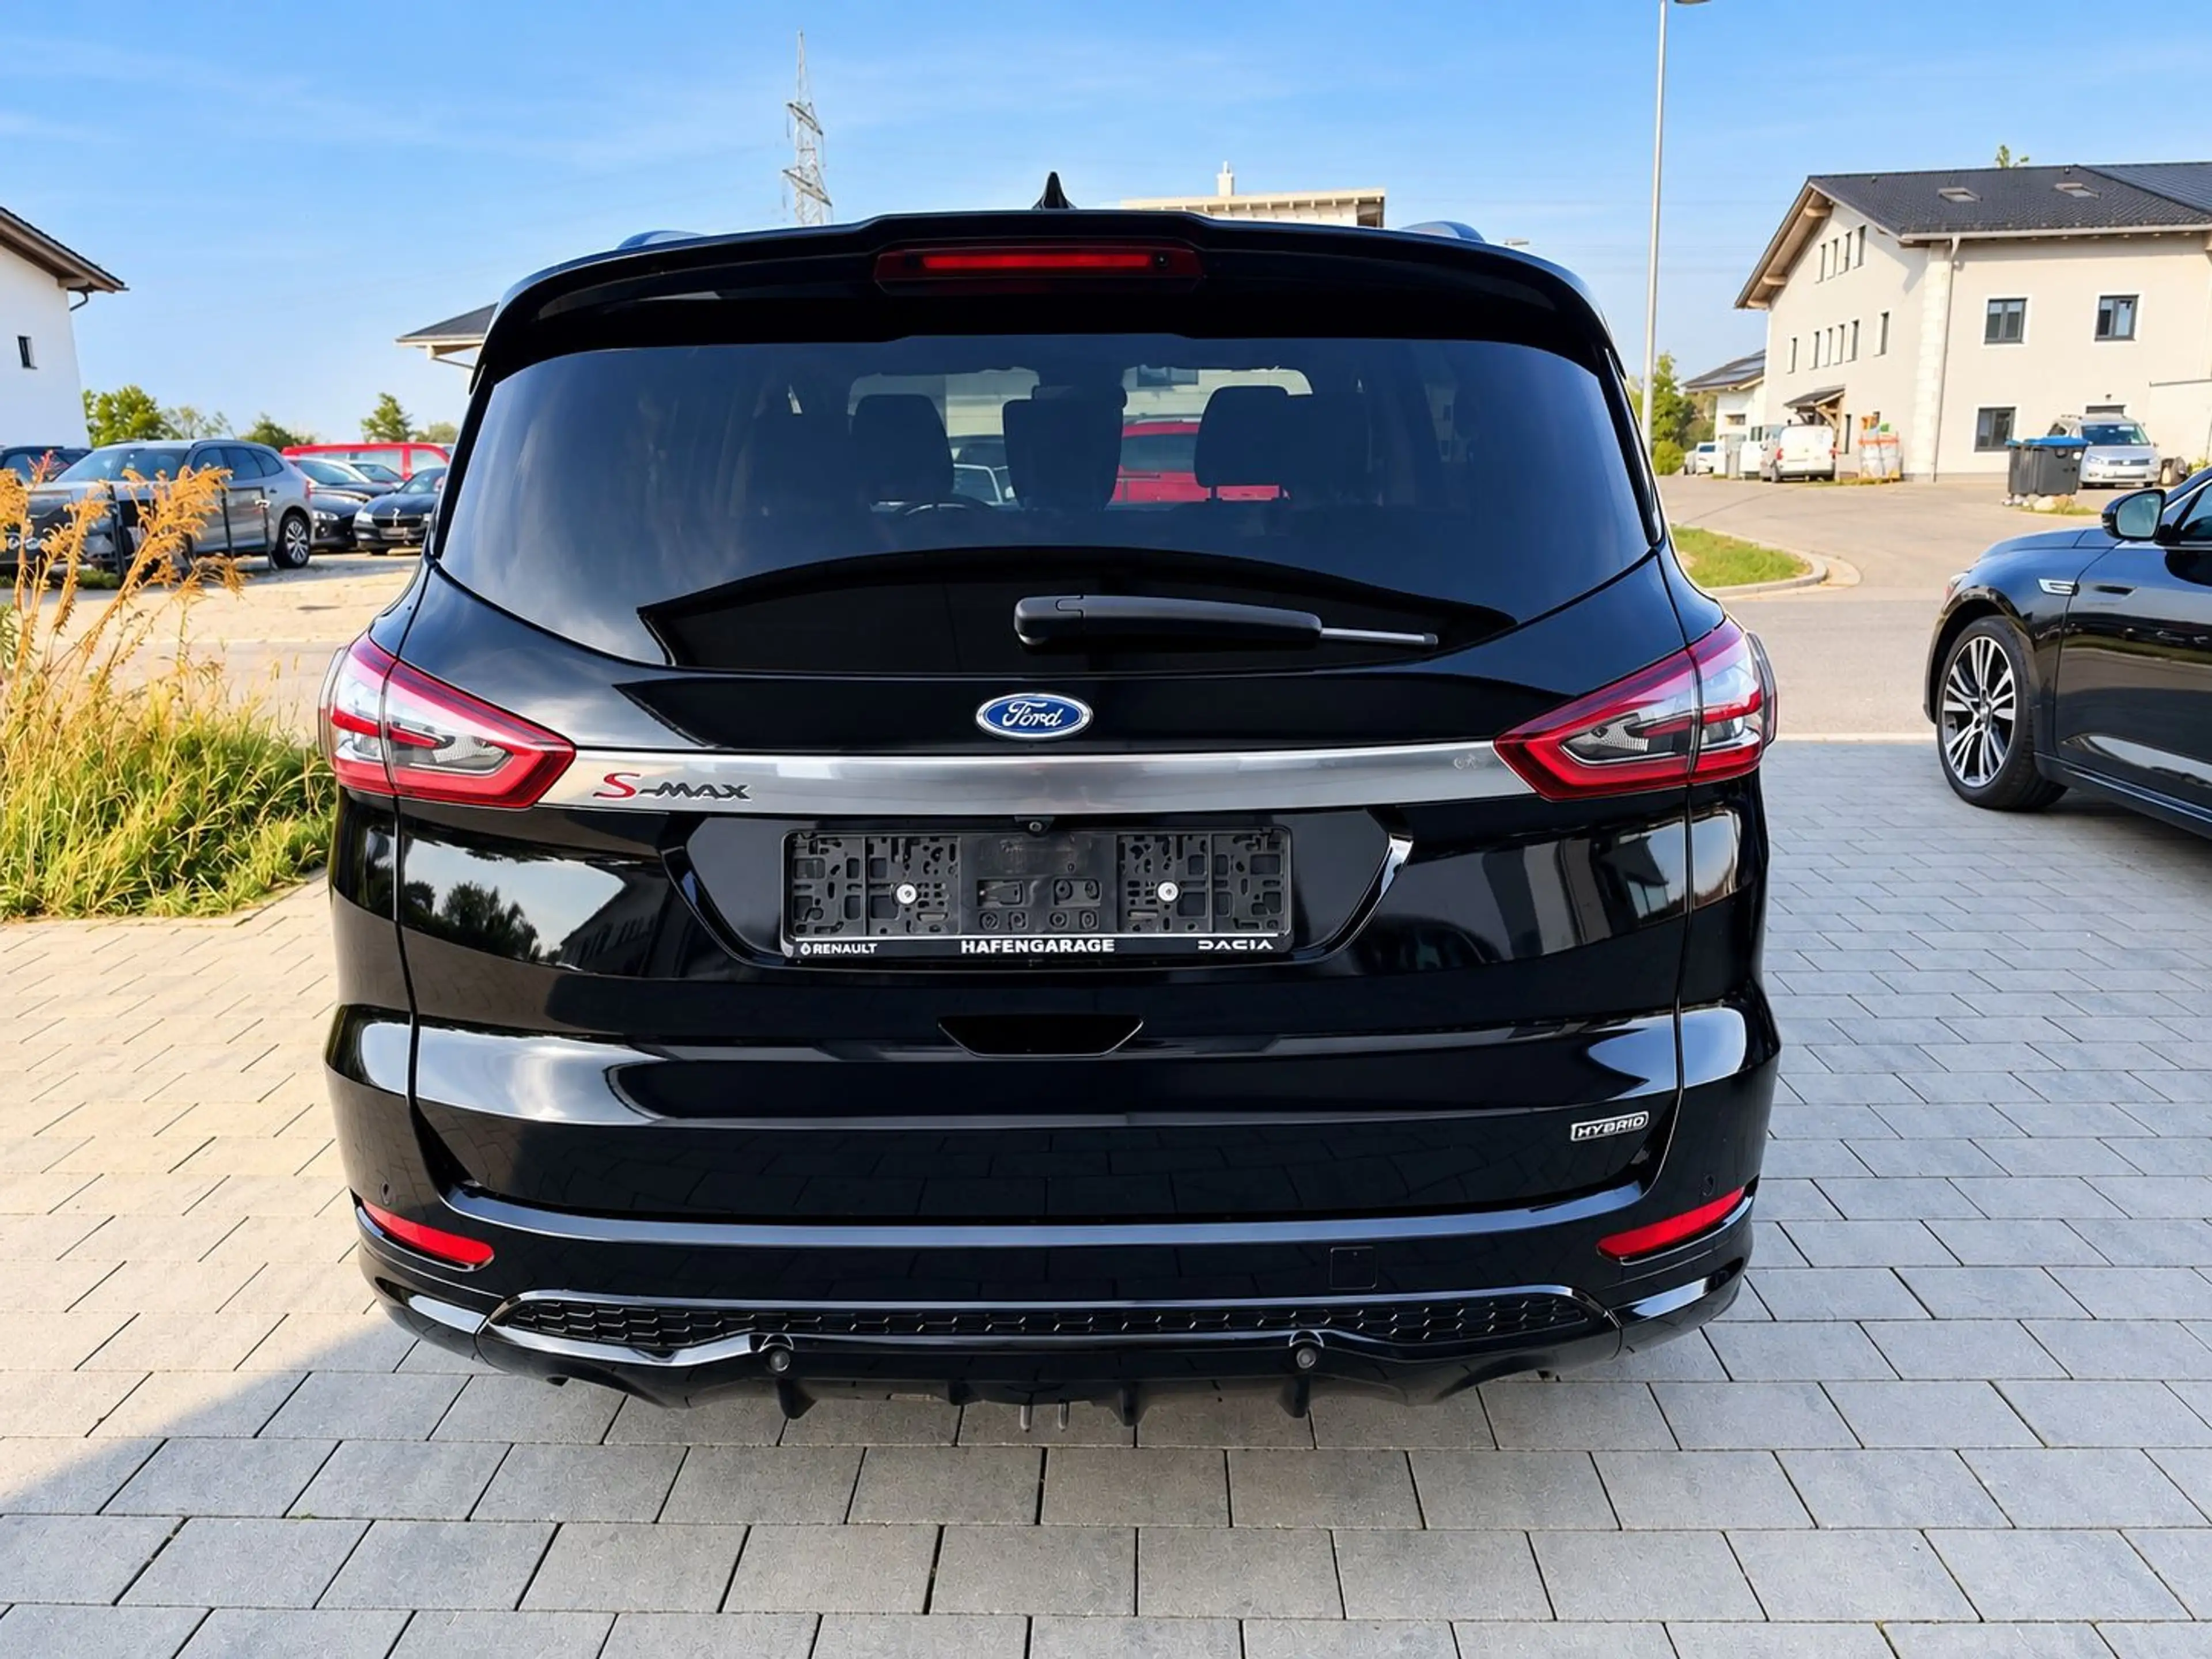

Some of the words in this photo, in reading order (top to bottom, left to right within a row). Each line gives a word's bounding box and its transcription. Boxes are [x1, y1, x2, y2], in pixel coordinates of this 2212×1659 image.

[1002, 701, 1064, 726] Ford
[813, 943, 877, 954] RENAULT
[961, 939, 1115, 953] HAFENGARAGE
[1198, 940, 1274, 950] DACIA
[1578, 1116, 1645, 1137] HYBRID
